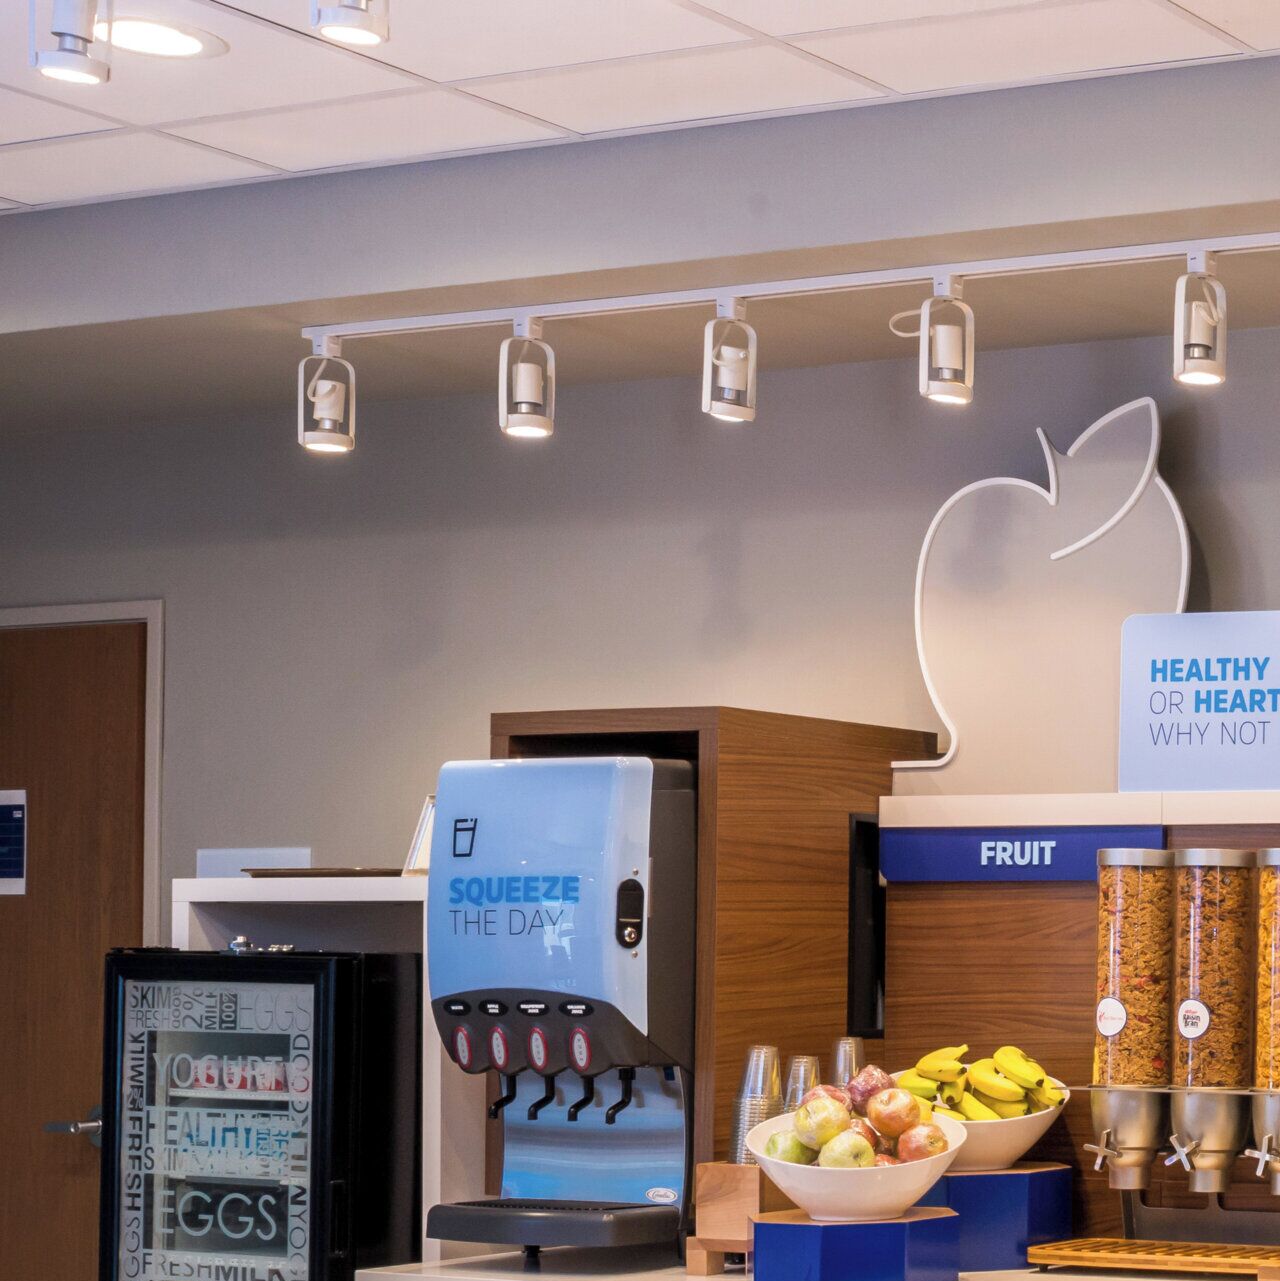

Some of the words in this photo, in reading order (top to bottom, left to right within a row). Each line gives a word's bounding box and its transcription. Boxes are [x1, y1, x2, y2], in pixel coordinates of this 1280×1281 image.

[1150, 656, 1271, 683] HEALTHY
[1149, 690, 1184, 715] OR
[1149, 722, 1210, 746] WHY
[1220, 721, 1271, 746] NOT
[980, 840, 1057, 866] FRUIT
[448, 875, 580, 907] SQUEEZE
[448, 909, 497, 936] THE
[508, 908, 564, 936] DAY
[130, 985, 171, 1009] SKIM
[128, 1009, 171, 1029] FRESH
[126, 1116, 143, 1212] FRESH
[160, 1190, 278, 1241] EGGS
[142, 1252, 212, 1279] FRESH
